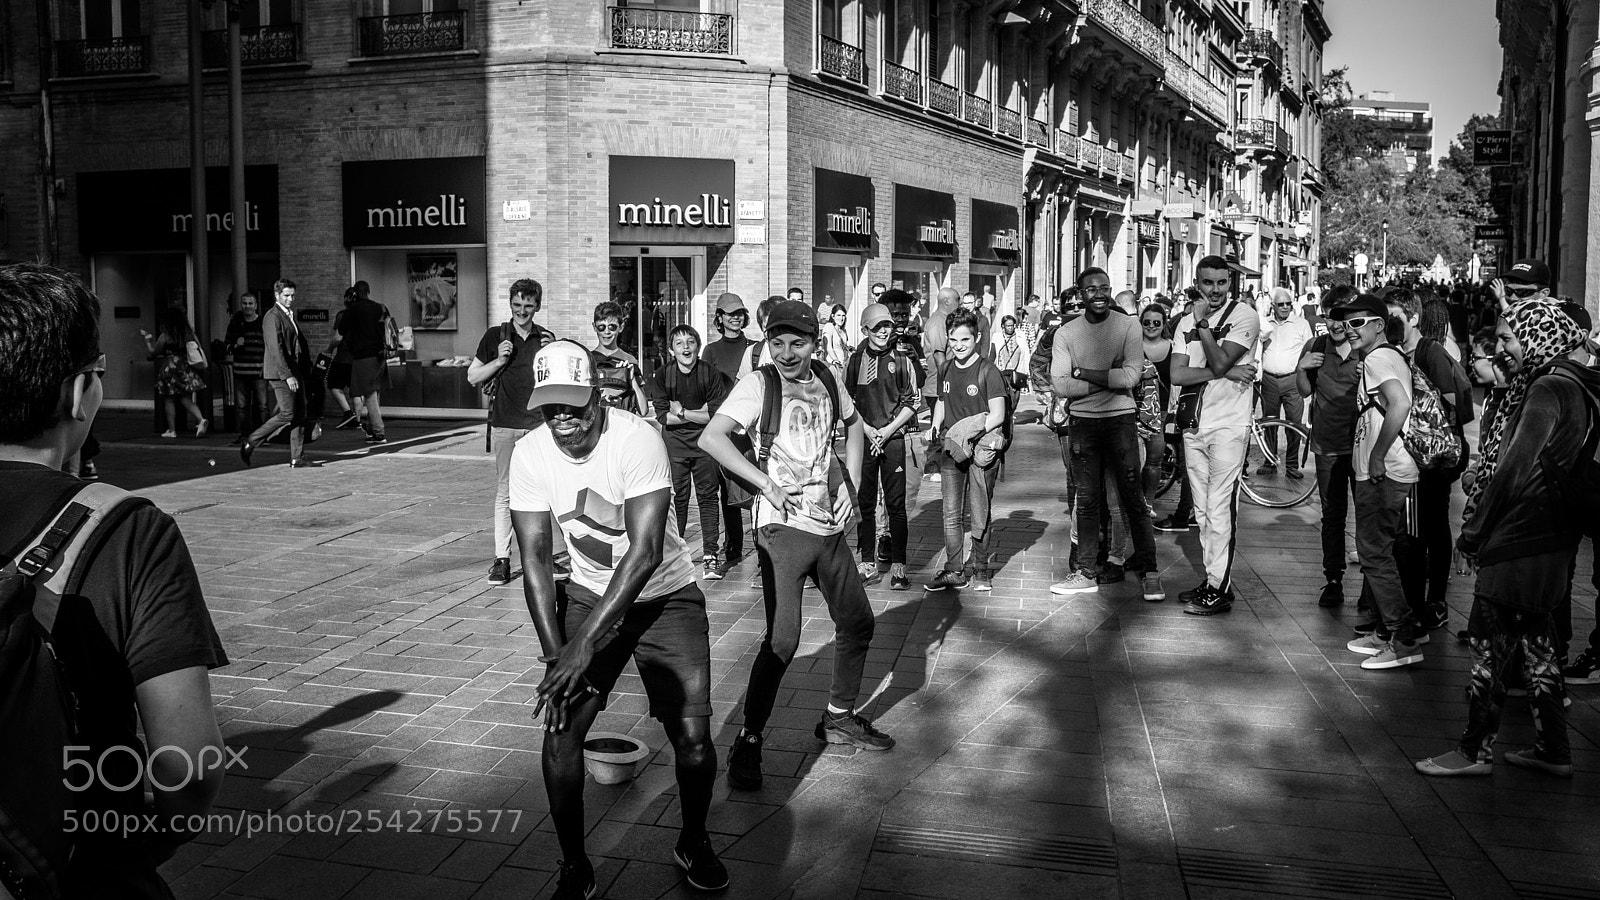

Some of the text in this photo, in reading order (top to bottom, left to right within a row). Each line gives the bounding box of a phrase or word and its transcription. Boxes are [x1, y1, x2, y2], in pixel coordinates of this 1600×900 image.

[1486, 135, 1510, 144] Pierre
[171, 201, 260, 232] mneli
[367, 194, 467, 228] minelli
[618, 193, 731, 226] minelli
[830, 207, 871, 236] minelli
[923, 220, 954, 245] minelli
[993, 229, 1019, 251] minelli
[302, 311, 327, 320] minelli
[942, 380, 950, 394] 10
